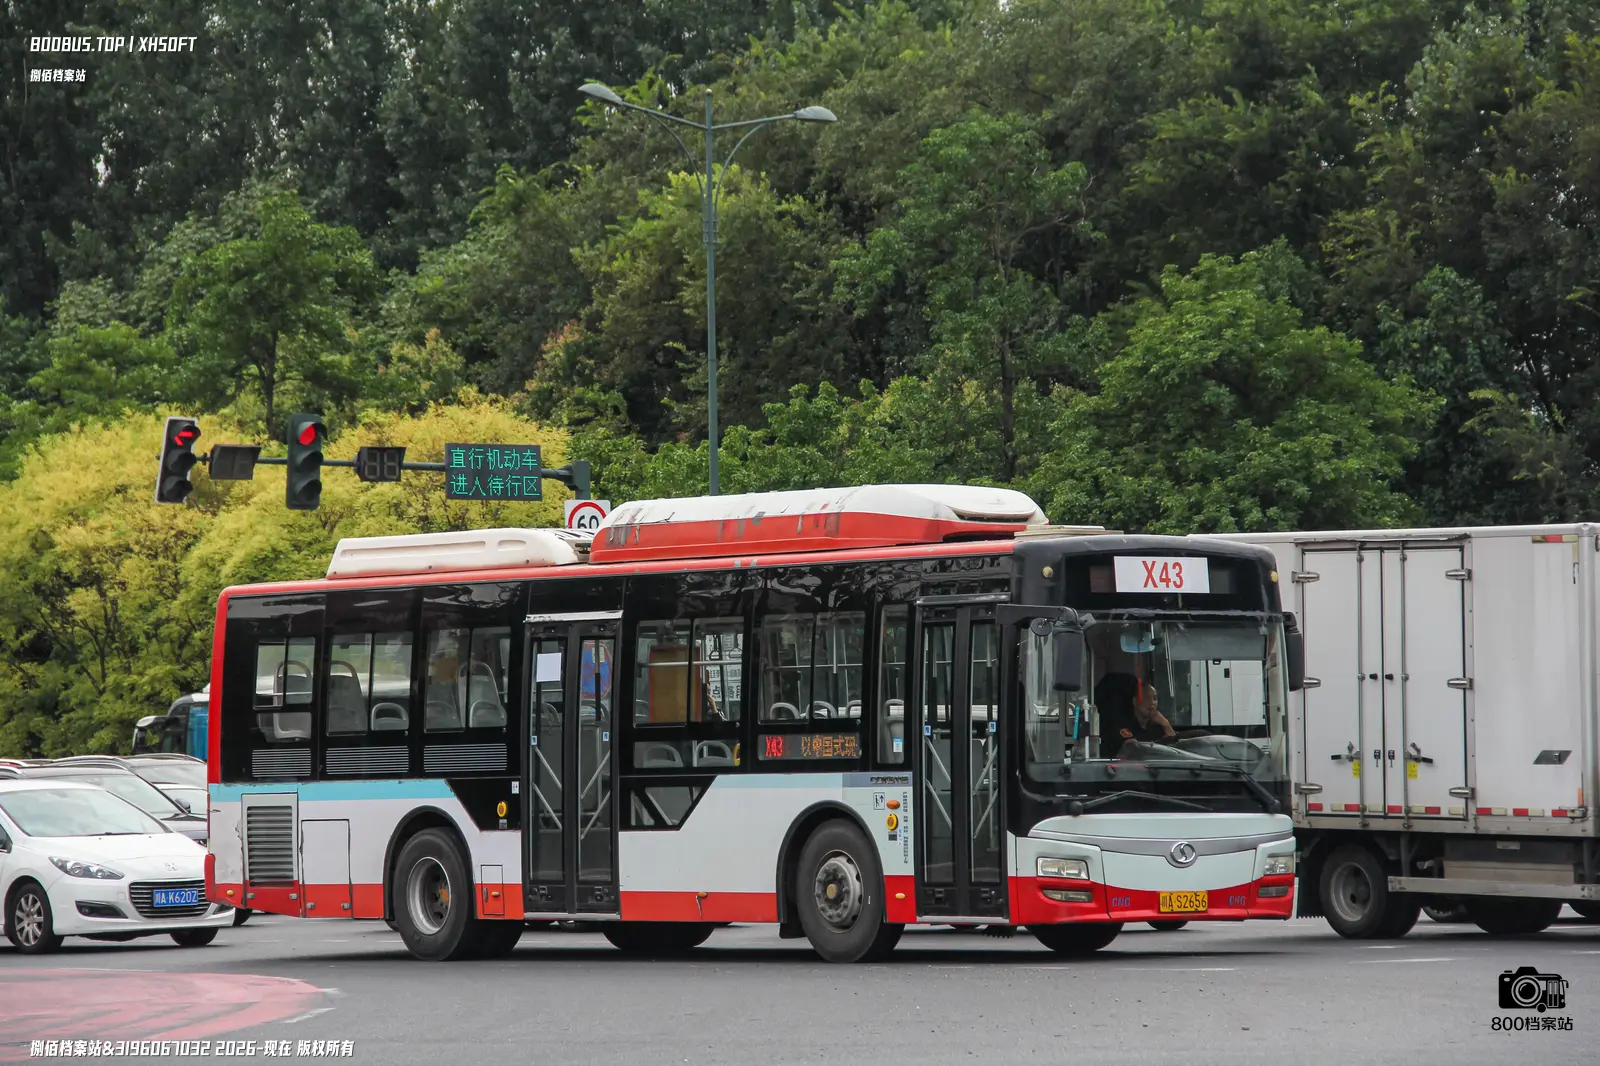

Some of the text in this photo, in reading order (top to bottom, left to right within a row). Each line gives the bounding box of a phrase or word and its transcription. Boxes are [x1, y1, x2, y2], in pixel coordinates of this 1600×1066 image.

[450, 447, 538, 471] 直行机动车
[450, 474, 541, 497] 进入待行区
[1141, 560, 1184, 589] X43
[765, 736, 783, 757] X43
